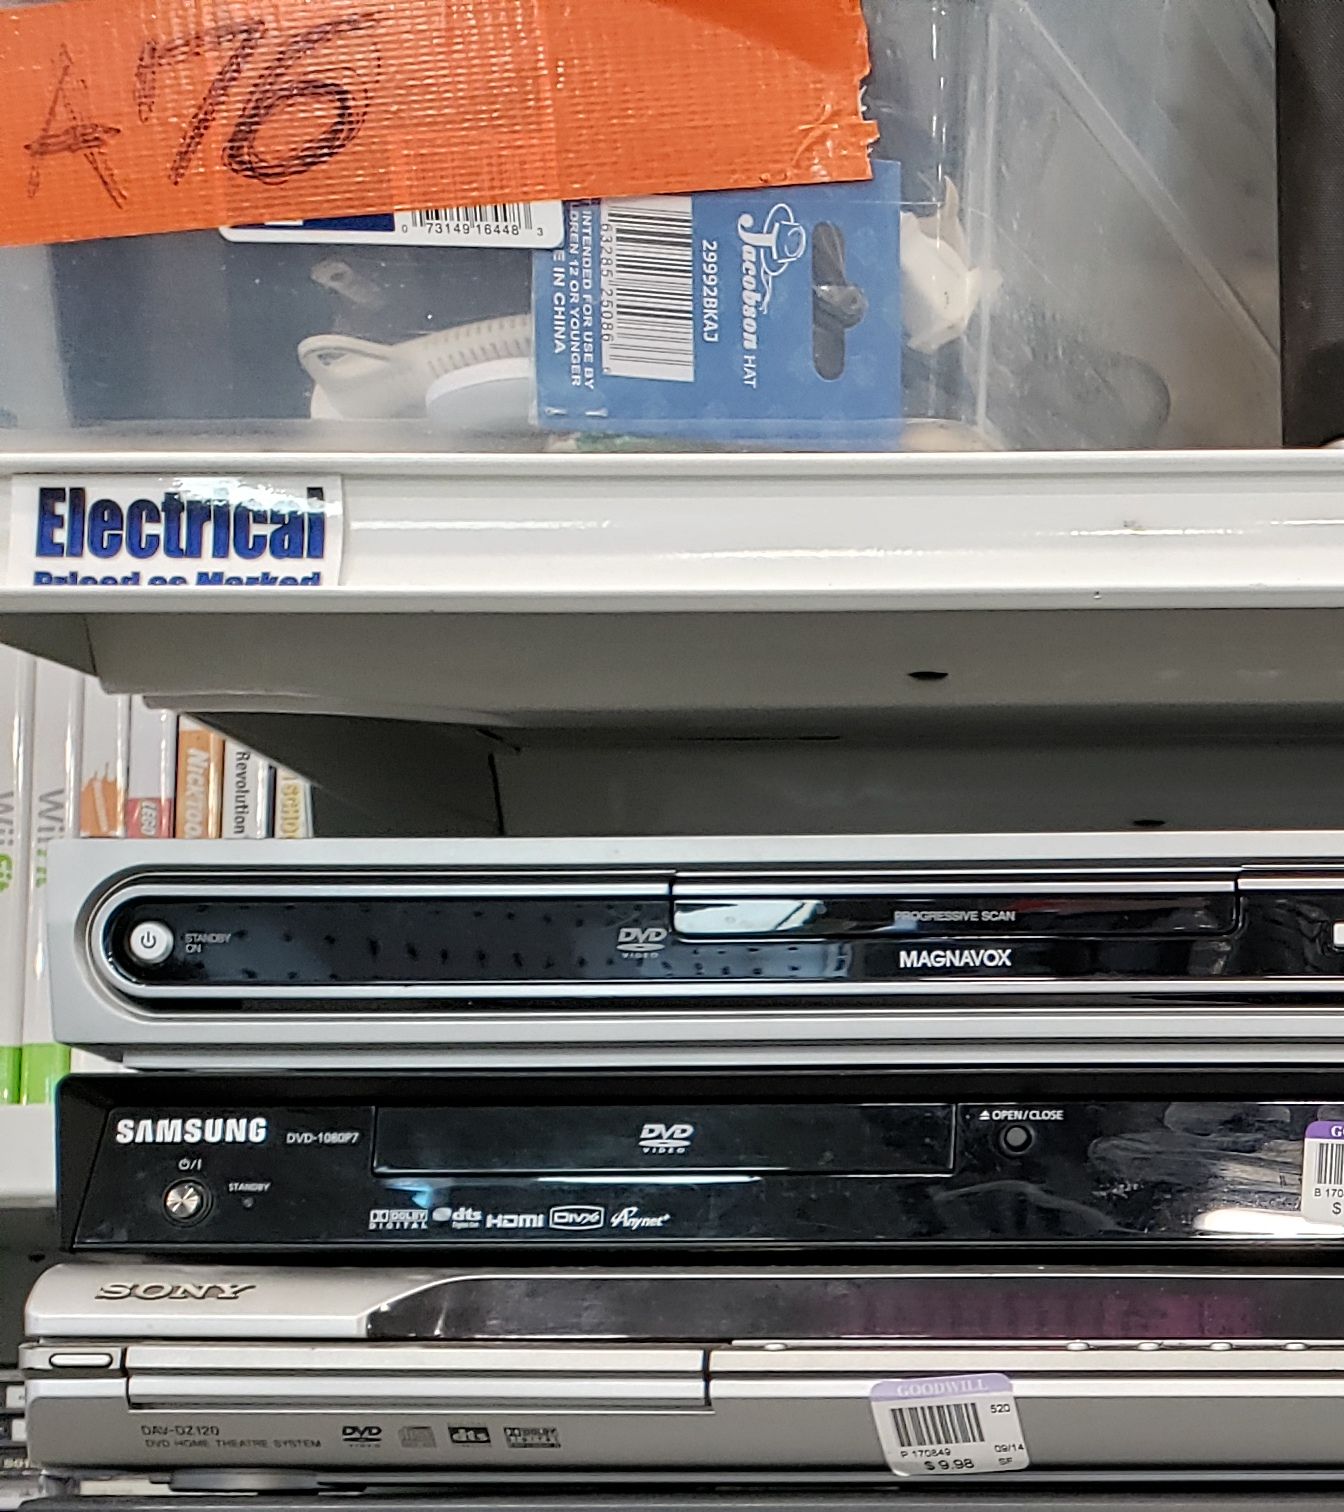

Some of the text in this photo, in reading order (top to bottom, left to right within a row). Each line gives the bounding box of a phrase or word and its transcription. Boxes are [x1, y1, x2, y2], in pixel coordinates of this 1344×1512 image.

[426, 223, 520, 235] 73149 16448
[582, 211, 594, 389] INTENDED FOR USE BY
[702, 240, 719, 342] 29992BKAJ
[738, 214, 779, 389] Jacobson HAT
[553, 292, 566, 354] CHINA
[570, 280, 581, 386] OR YOUNGER
[36, 487, 325, 559] Electrical
[233, 751, 251, 835] Revolution
[981, 910, 1015, 922] SCAN
[899, 949, 1012, 968] MAGNAVOX
[992, 1109, 1064, 1121] OPEN/CLOSE
[116, 1118, 267, 1144] SAMSUNG
[95, 1282, 256, 1300] SONY
[897, 1379, 988, 1396] GOODWILL
[990, 1404, 1010, 1414] 520
[175, 1439, 322, 1448] HOME THEATRE SYSTEM
[938, 1459, 975, 1470] 9.98
